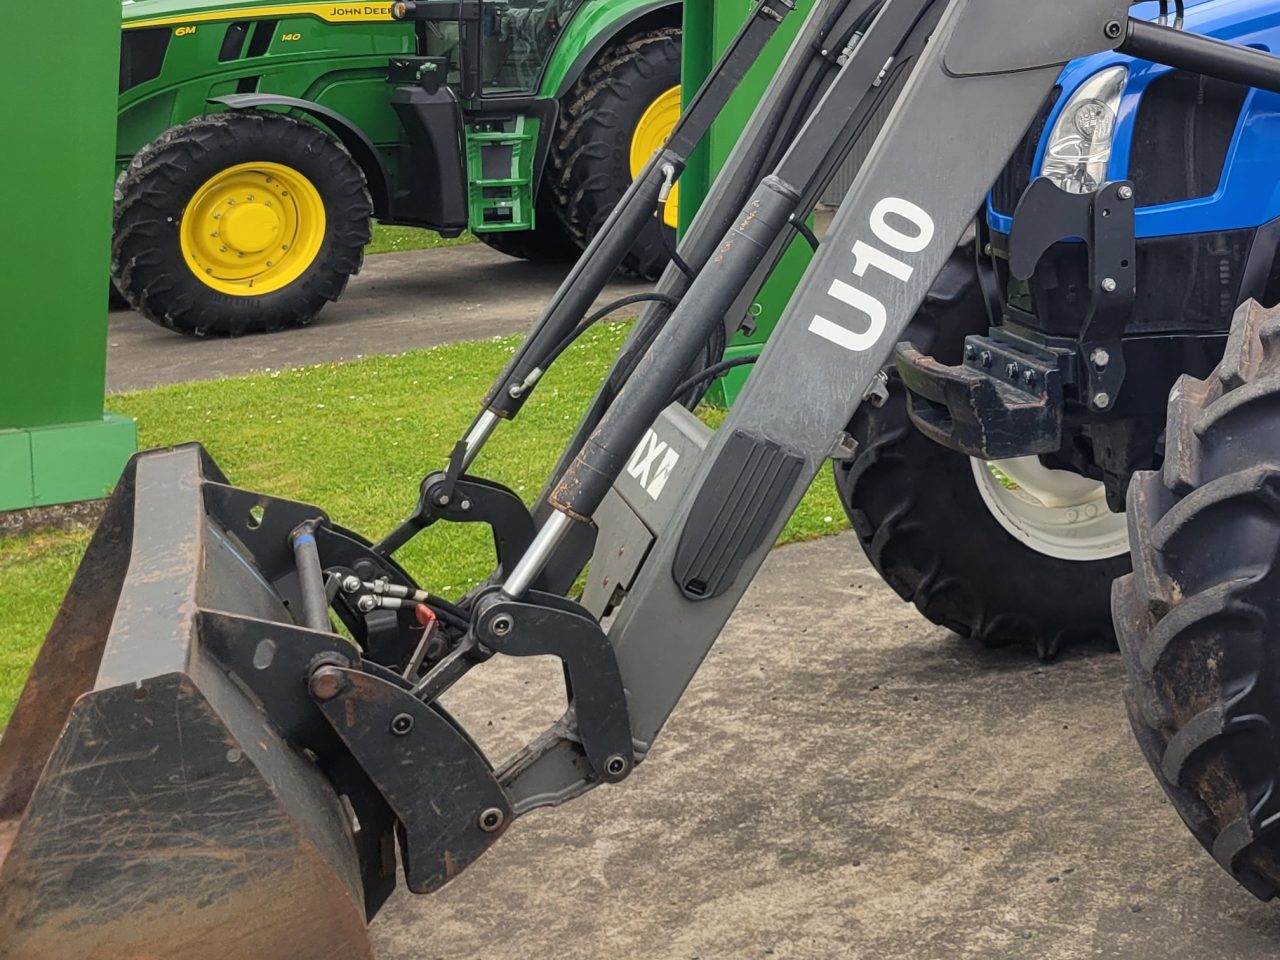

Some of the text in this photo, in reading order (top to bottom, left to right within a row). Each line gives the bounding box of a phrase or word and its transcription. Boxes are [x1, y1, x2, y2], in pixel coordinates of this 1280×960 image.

[330, 6, 392, 16] JOHN DEE
[175, 26, 196, 36] 6M
[281, 33, 301, 41] 140
[808, 197, 934, 351] U10
